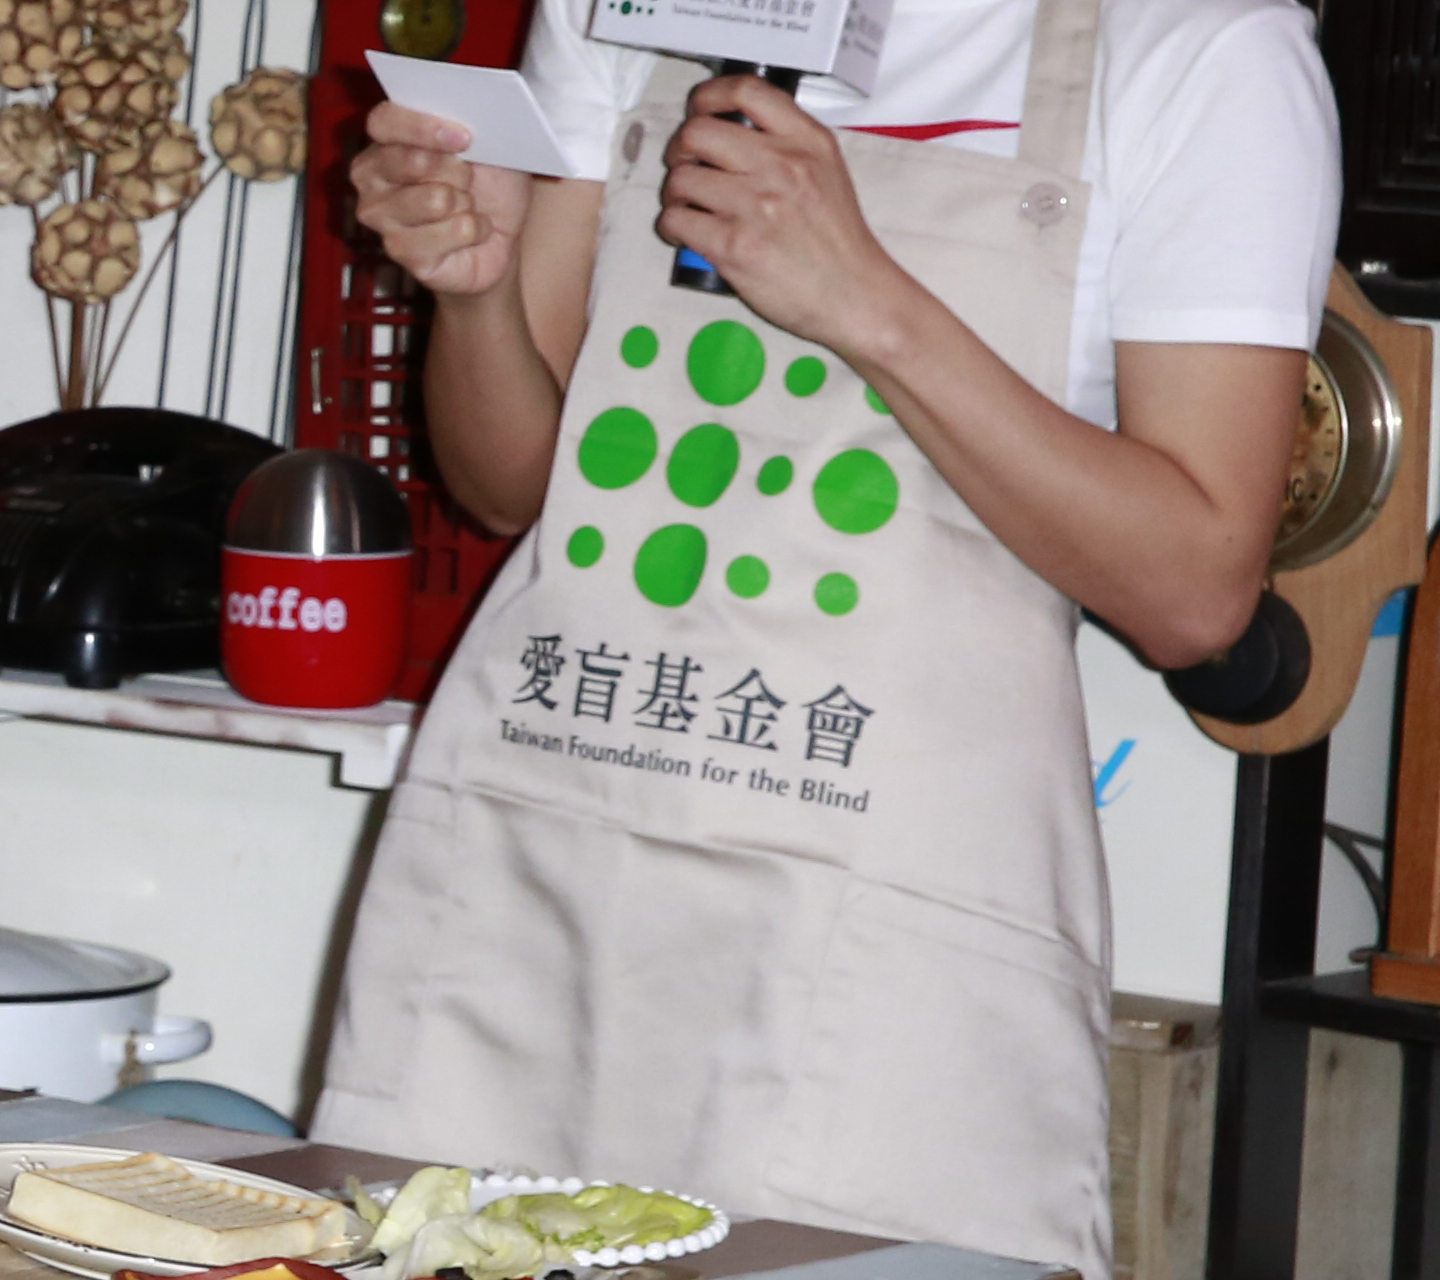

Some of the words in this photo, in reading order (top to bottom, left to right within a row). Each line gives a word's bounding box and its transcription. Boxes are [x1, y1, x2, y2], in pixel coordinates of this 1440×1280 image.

[226, 585, 349, 634] coffee
[511, 632, 876, 770] 愛盲基金會
[499, 718, 564, 754] Taiwan
[567, 734, 692, 778] Foundation
[700, 756, 740, 786] for
[748, 768, 792, 797] the
[799, 779, 871, 815] Blind
